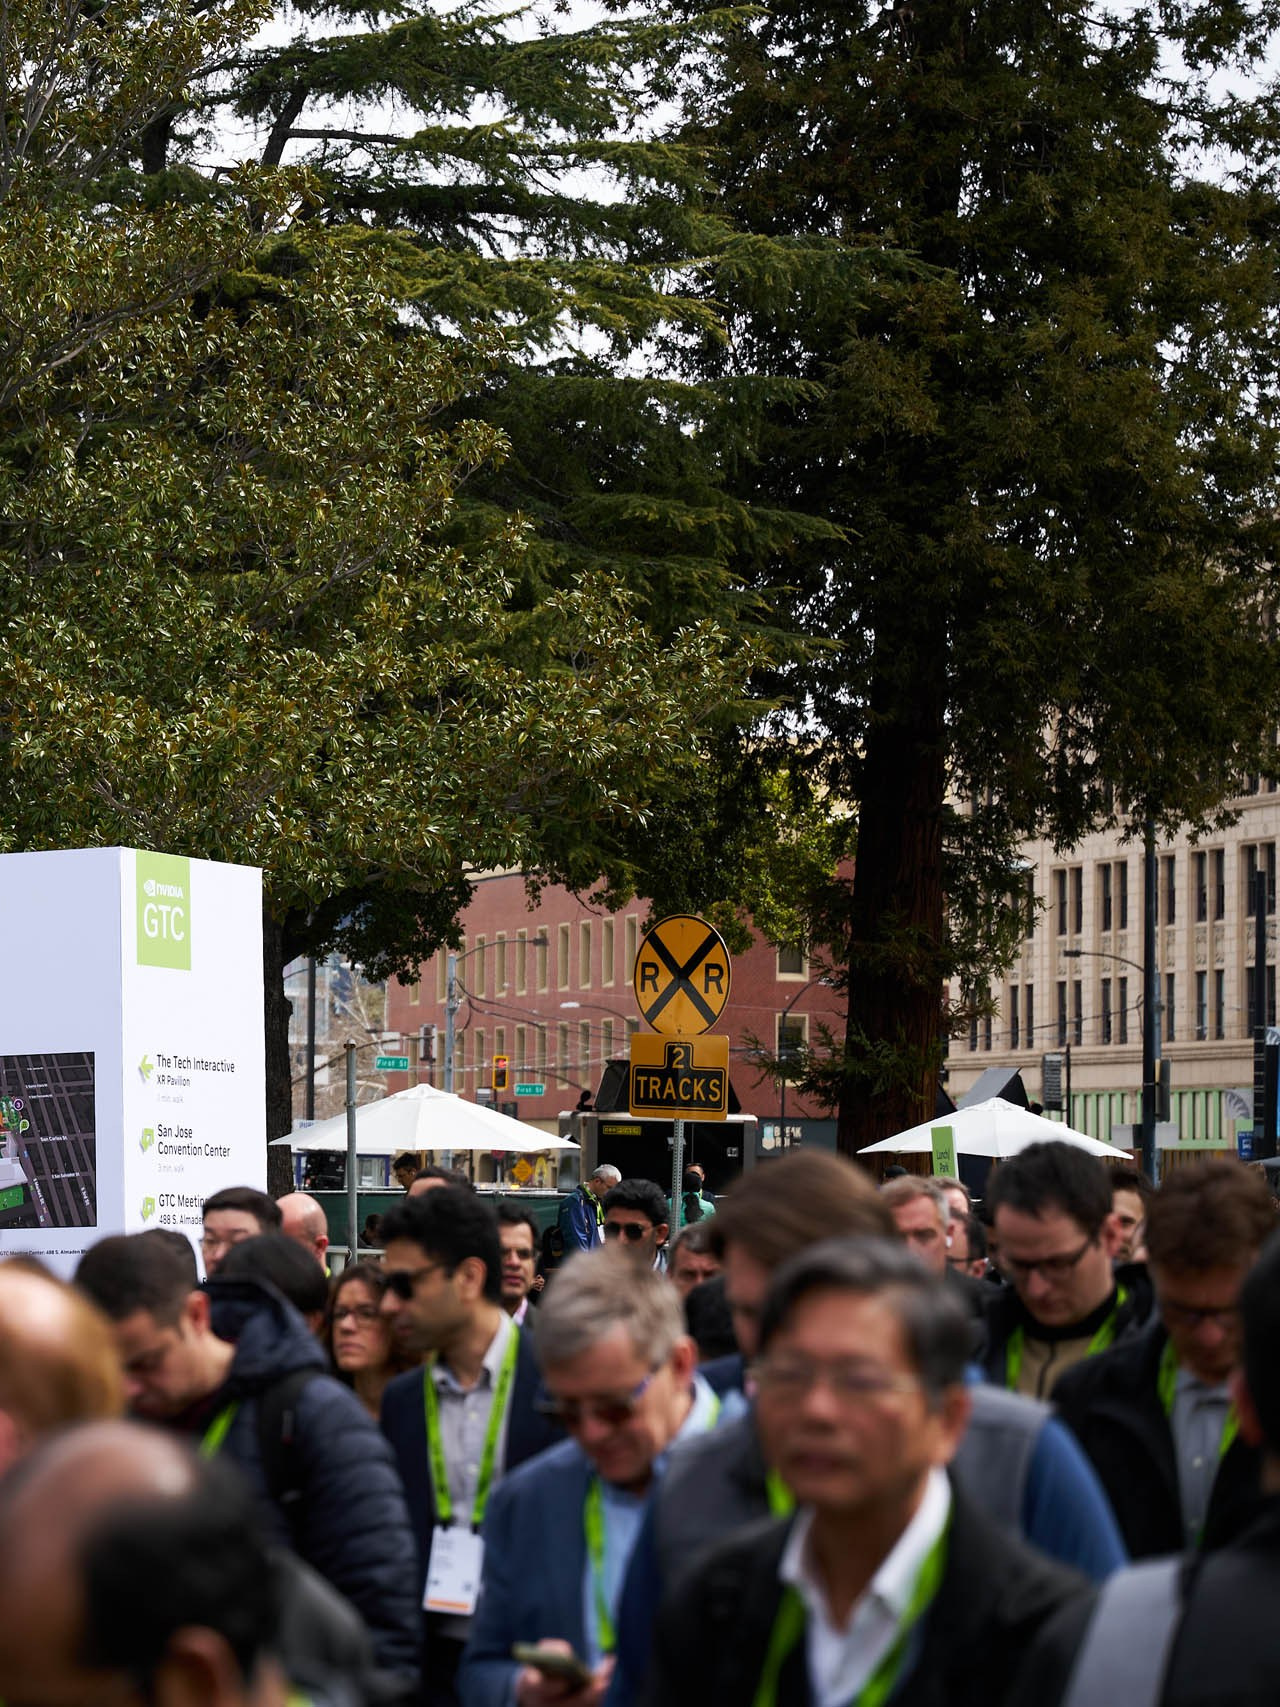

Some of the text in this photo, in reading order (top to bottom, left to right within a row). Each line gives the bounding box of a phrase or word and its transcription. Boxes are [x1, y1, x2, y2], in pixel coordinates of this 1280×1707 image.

[156, 882, 183, 899] NVIDIA
[143, 902, 185, 941] GTC
[640, 961, 659, 992] R
[704, 963, 724, 994] R
[157, 1054, 235, 1073] The Tech Interactive
[376, 1057, 408, 1067] First St
[672, 1047, 685, 1069] 2
[157, 1074, 191, 1087] XR Pavilion
[516, 1085, 543, 1093] First St
[637, 1075, 721, 1102] TRACKS
[157, 1124, 193, 1139] San Jose
[157, 1141, 231, 1158] Convention Center
[158, 1193, 176, 1208] GTC
[159, 1214, 171, 1225] 488
